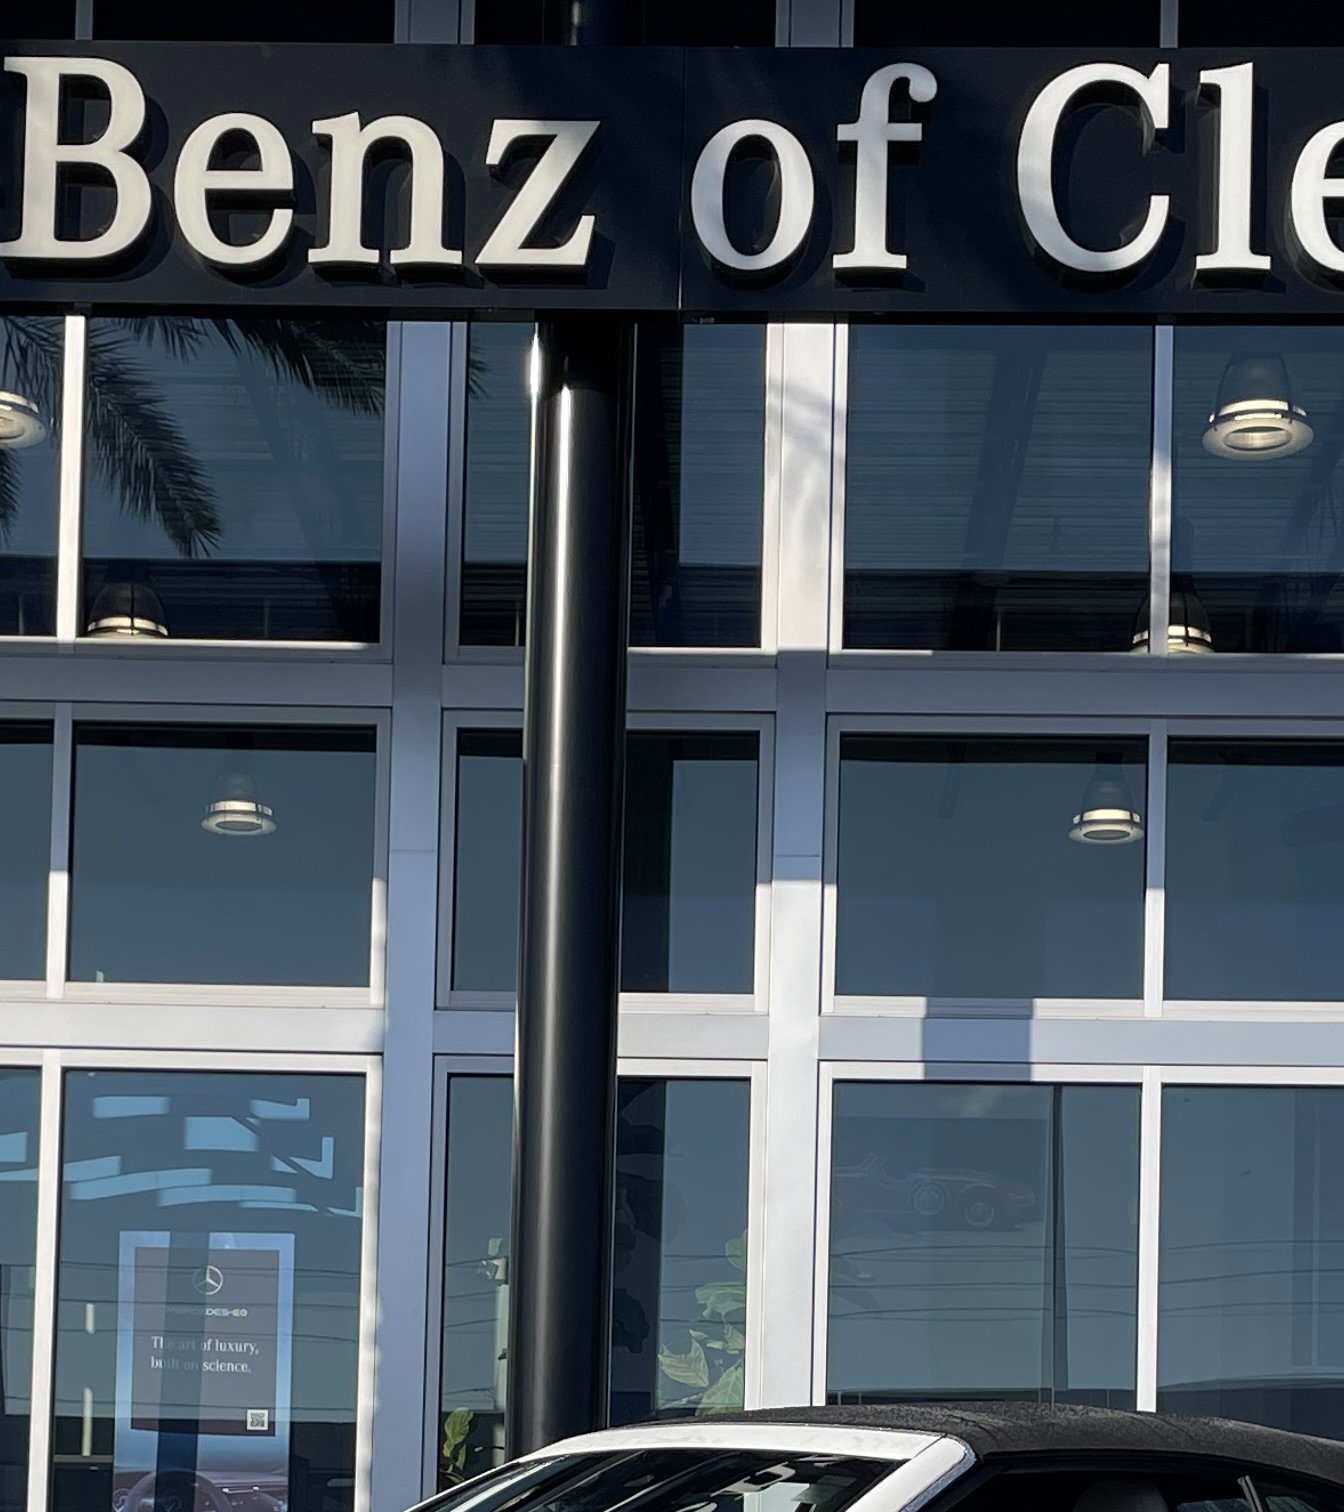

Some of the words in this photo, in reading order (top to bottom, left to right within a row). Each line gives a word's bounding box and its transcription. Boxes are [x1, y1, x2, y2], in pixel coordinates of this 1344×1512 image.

[691, 62, 938, 271] of
[200, 1338, 213, 1352] of
[215, 1339, 259, 1356] luxury,
[202, 1360, 252, 1373] science.
